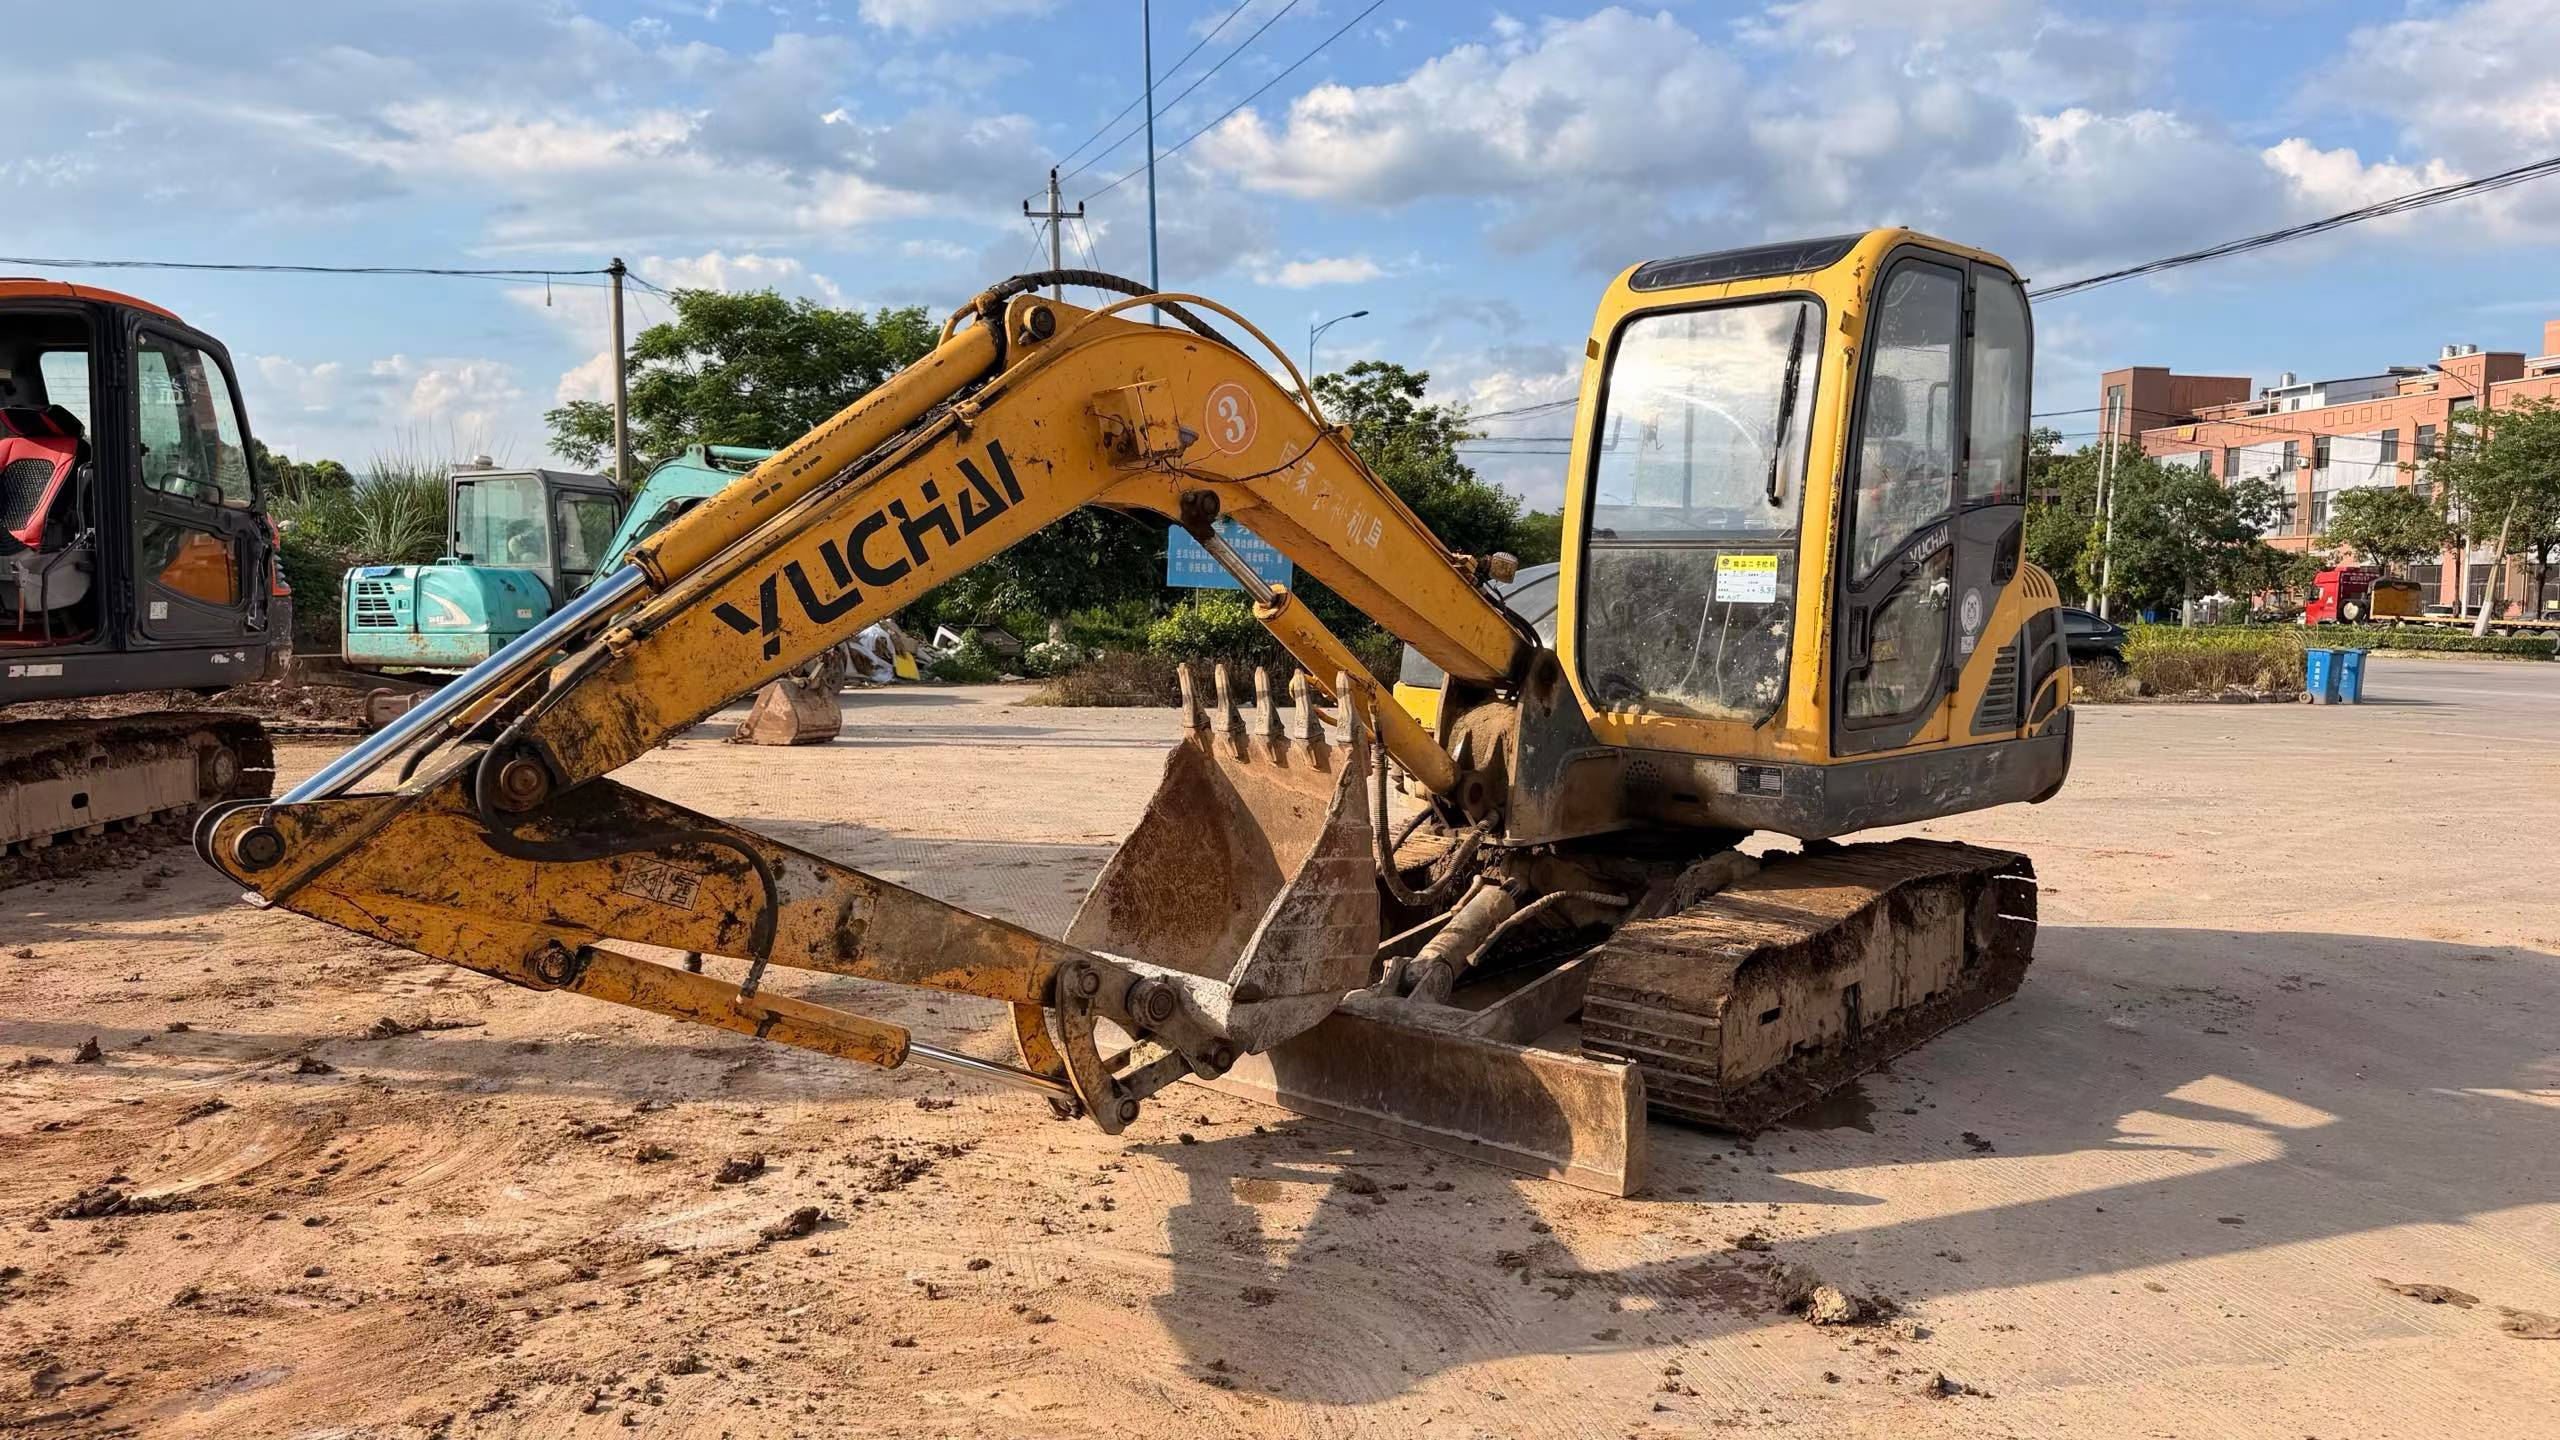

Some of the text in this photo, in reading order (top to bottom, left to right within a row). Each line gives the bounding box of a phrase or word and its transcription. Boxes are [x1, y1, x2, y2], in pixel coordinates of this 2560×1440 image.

[1217, 395, 1246, 443] 3
[711, 438, 1025, 661] YUCHAI
[1909, 525, 1949, 561] YUCHAI
